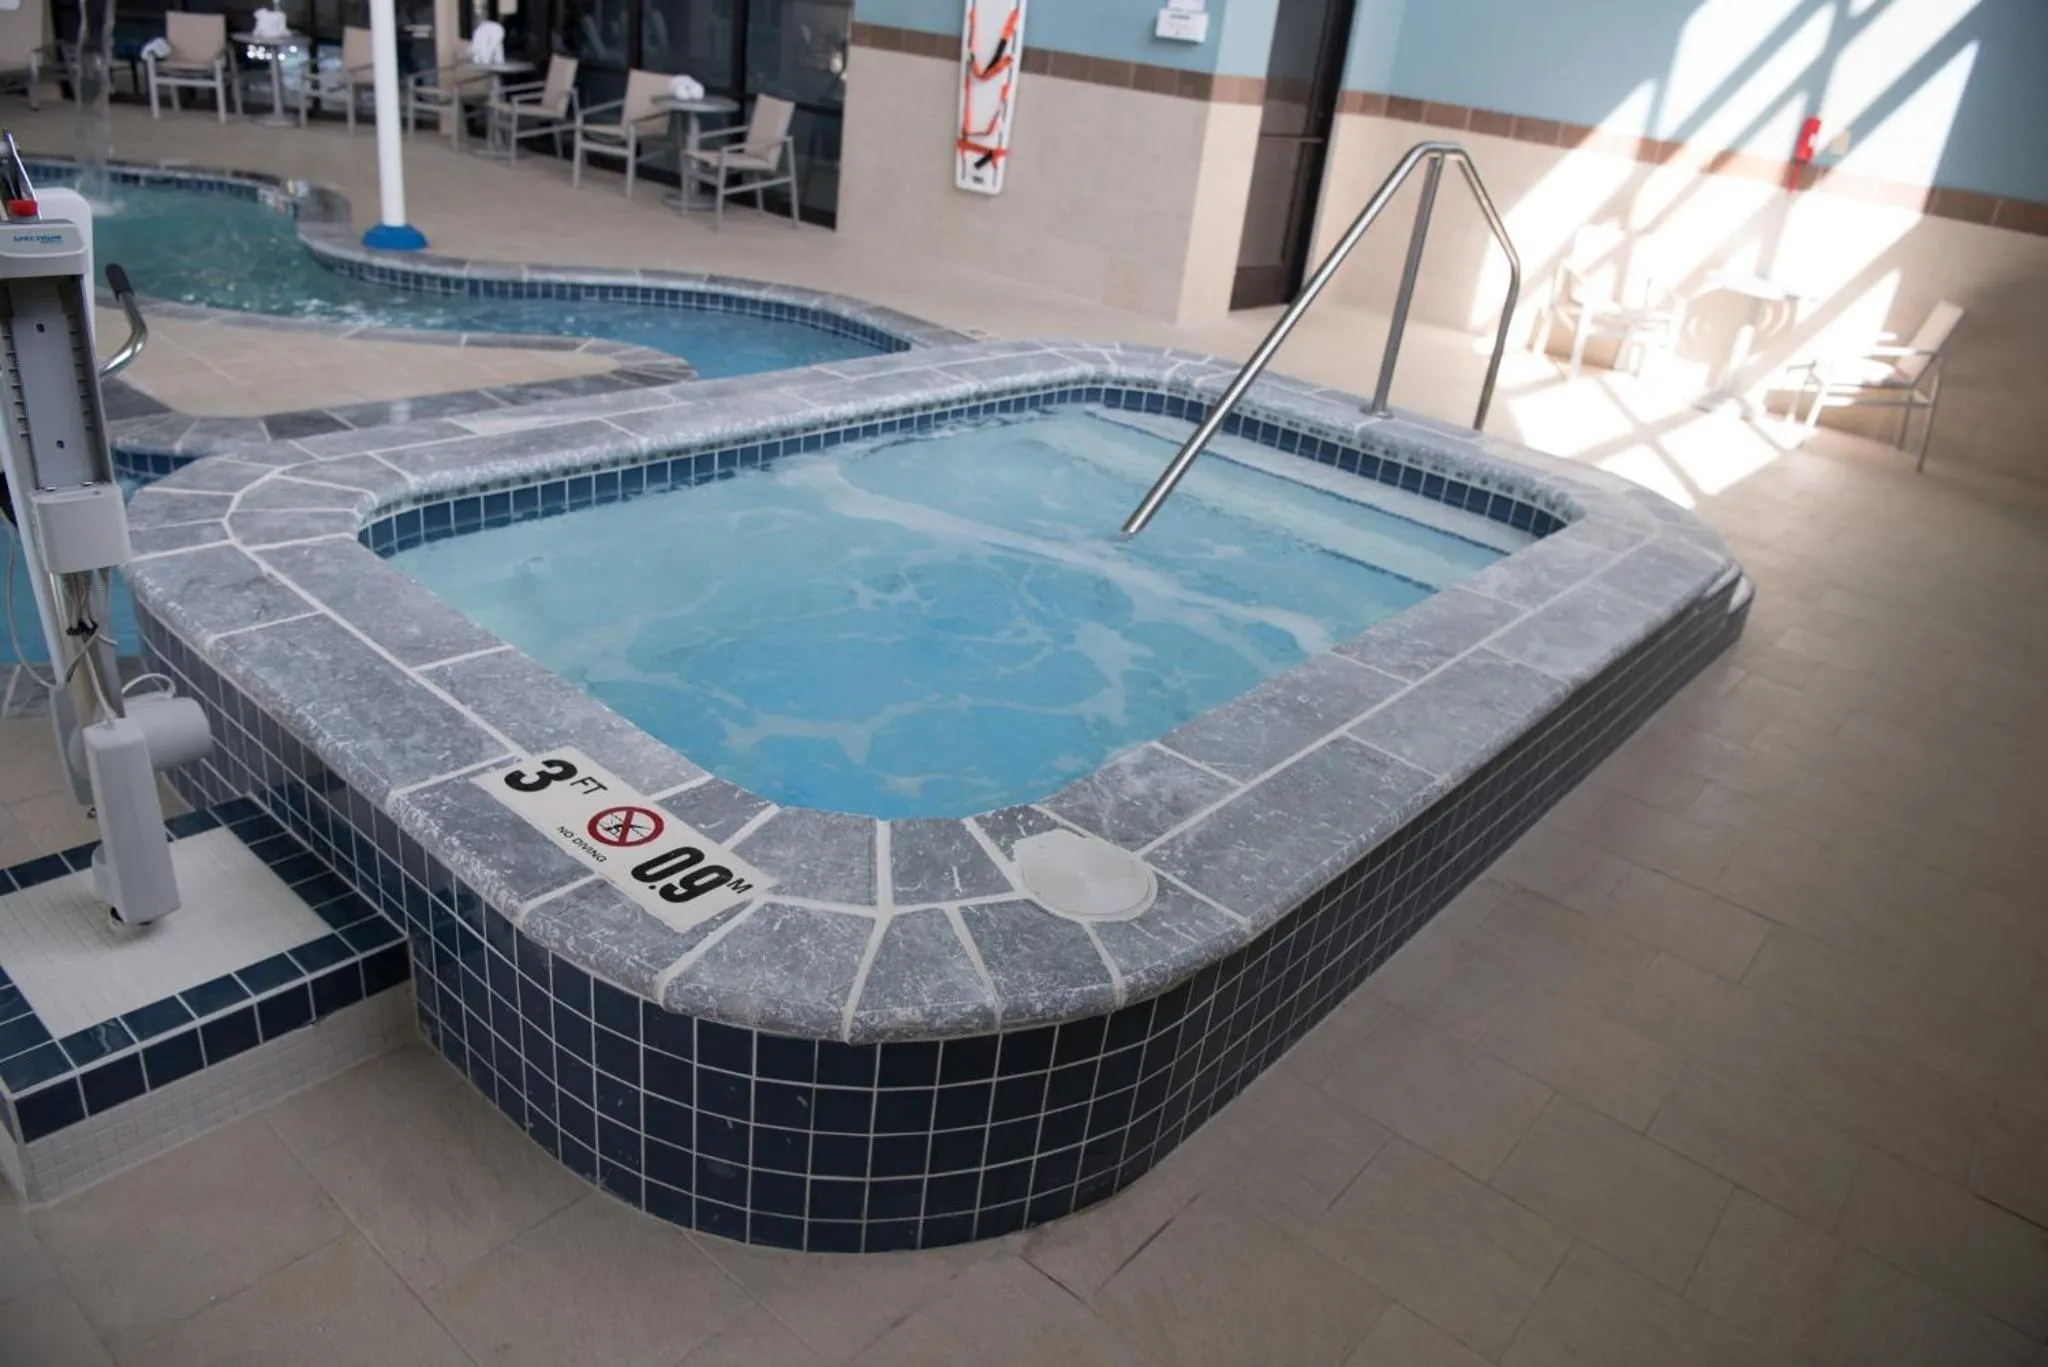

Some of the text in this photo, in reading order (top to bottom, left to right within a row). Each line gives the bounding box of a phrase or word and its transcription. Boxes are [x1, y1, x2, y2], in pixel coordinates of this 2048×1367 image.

[504, 759, 608, 795] 3 FT
[556, 825, 608, 864] NO DIVING
[631, 846, 754, 903] 0.9 M
